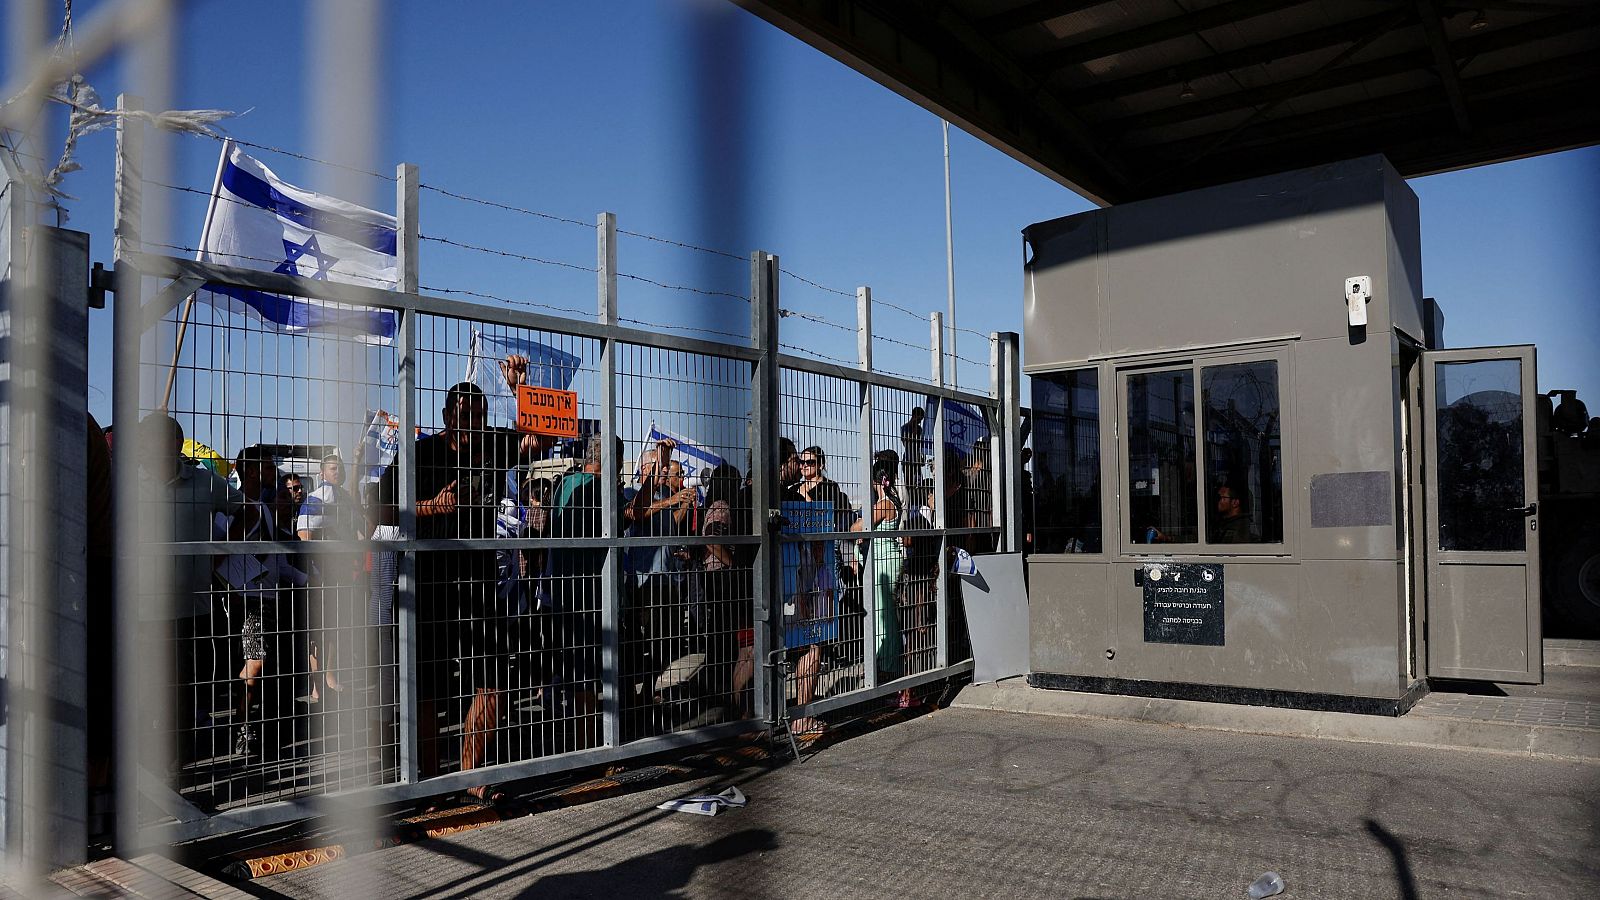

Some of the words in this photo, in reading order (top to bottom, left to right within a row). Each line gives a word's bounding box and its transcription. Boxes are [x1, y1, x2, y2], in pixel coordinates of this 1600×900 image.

[526, 391, 554, 408] מעבר
[556, 395, 571, 411] אין
[520, 411, 539, 427] רגל
[541, 414, 575, 431] להולכי
